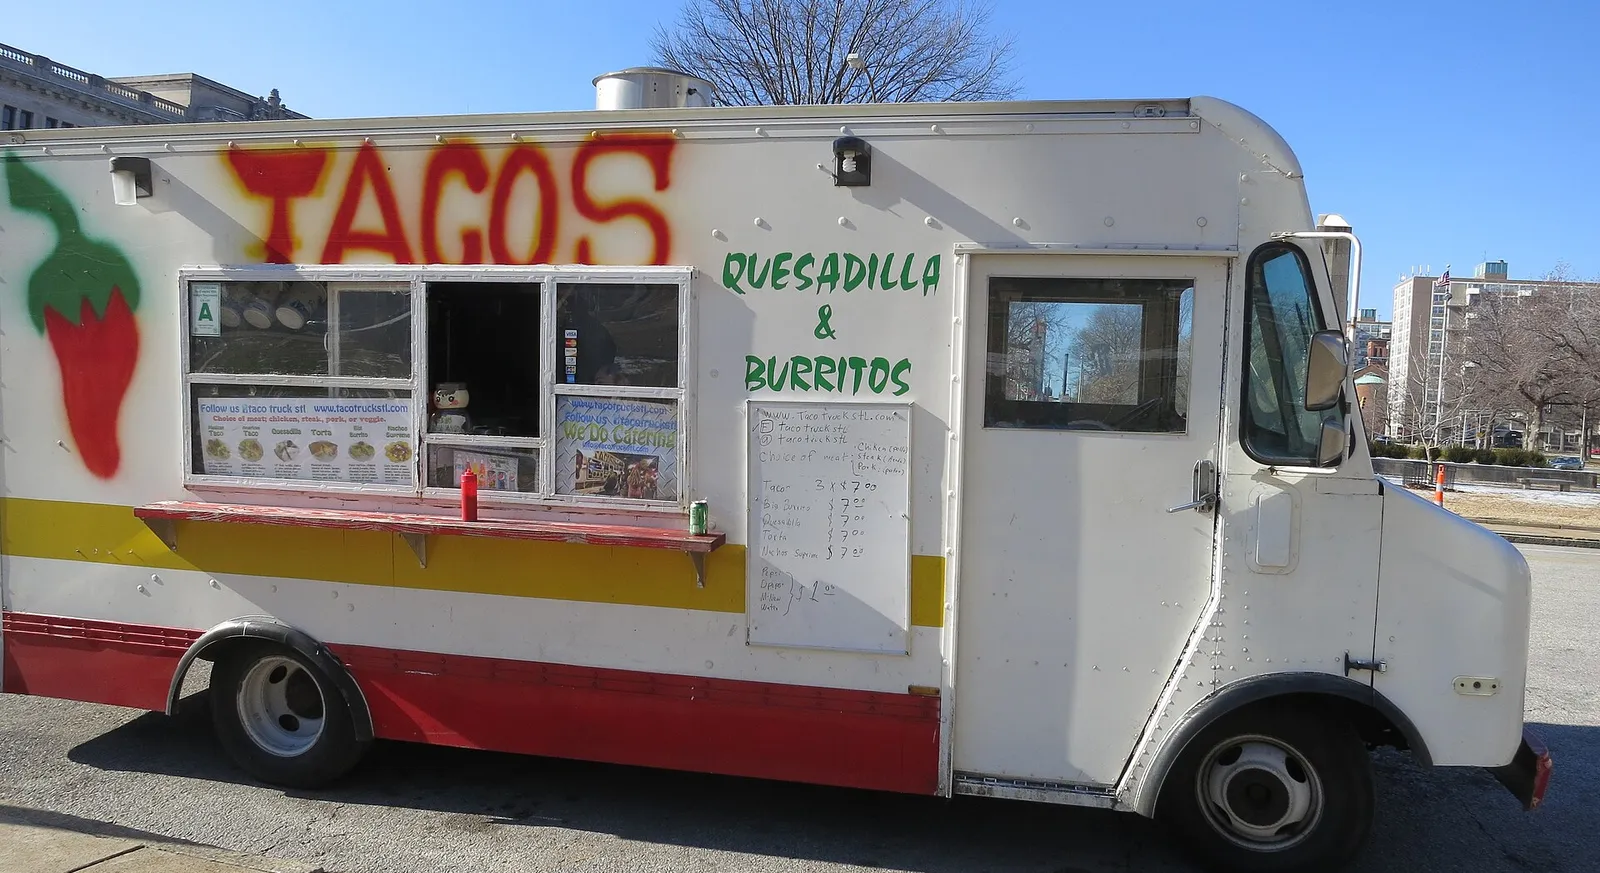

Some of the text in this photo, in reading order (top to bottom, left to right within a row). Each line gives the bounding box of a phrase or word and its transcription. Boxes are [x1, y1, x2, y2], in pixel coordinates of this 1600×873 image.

[223, 132, 678, 265] TACOS
[722, 252, 941, 297] QUESADILLA
[198, 302, 213, 321] A
[813, 304, 837, 340] &
[744, 355, 912, 397] BURRITOS
[200, 404, 228, 413] Follow
[229, 405, 240, 413] us
[269, 403, 293, 413] truck
[294, 404, 307, 413] stl
[313, 403, 408, 413] www.tacotruckstl.com
[268, 415, 300, 423] chicken,
[301, 415, 324, 423] steak,
[325, 416, 347, 424] pork,
[359, 416, 387, 424] veggie.
[563, 421, 677, 448] We Do Catering
[758, 450, 797, 463] Choice
[800, 450, 817, 461] of
[814, 479, 825, 491] 3
